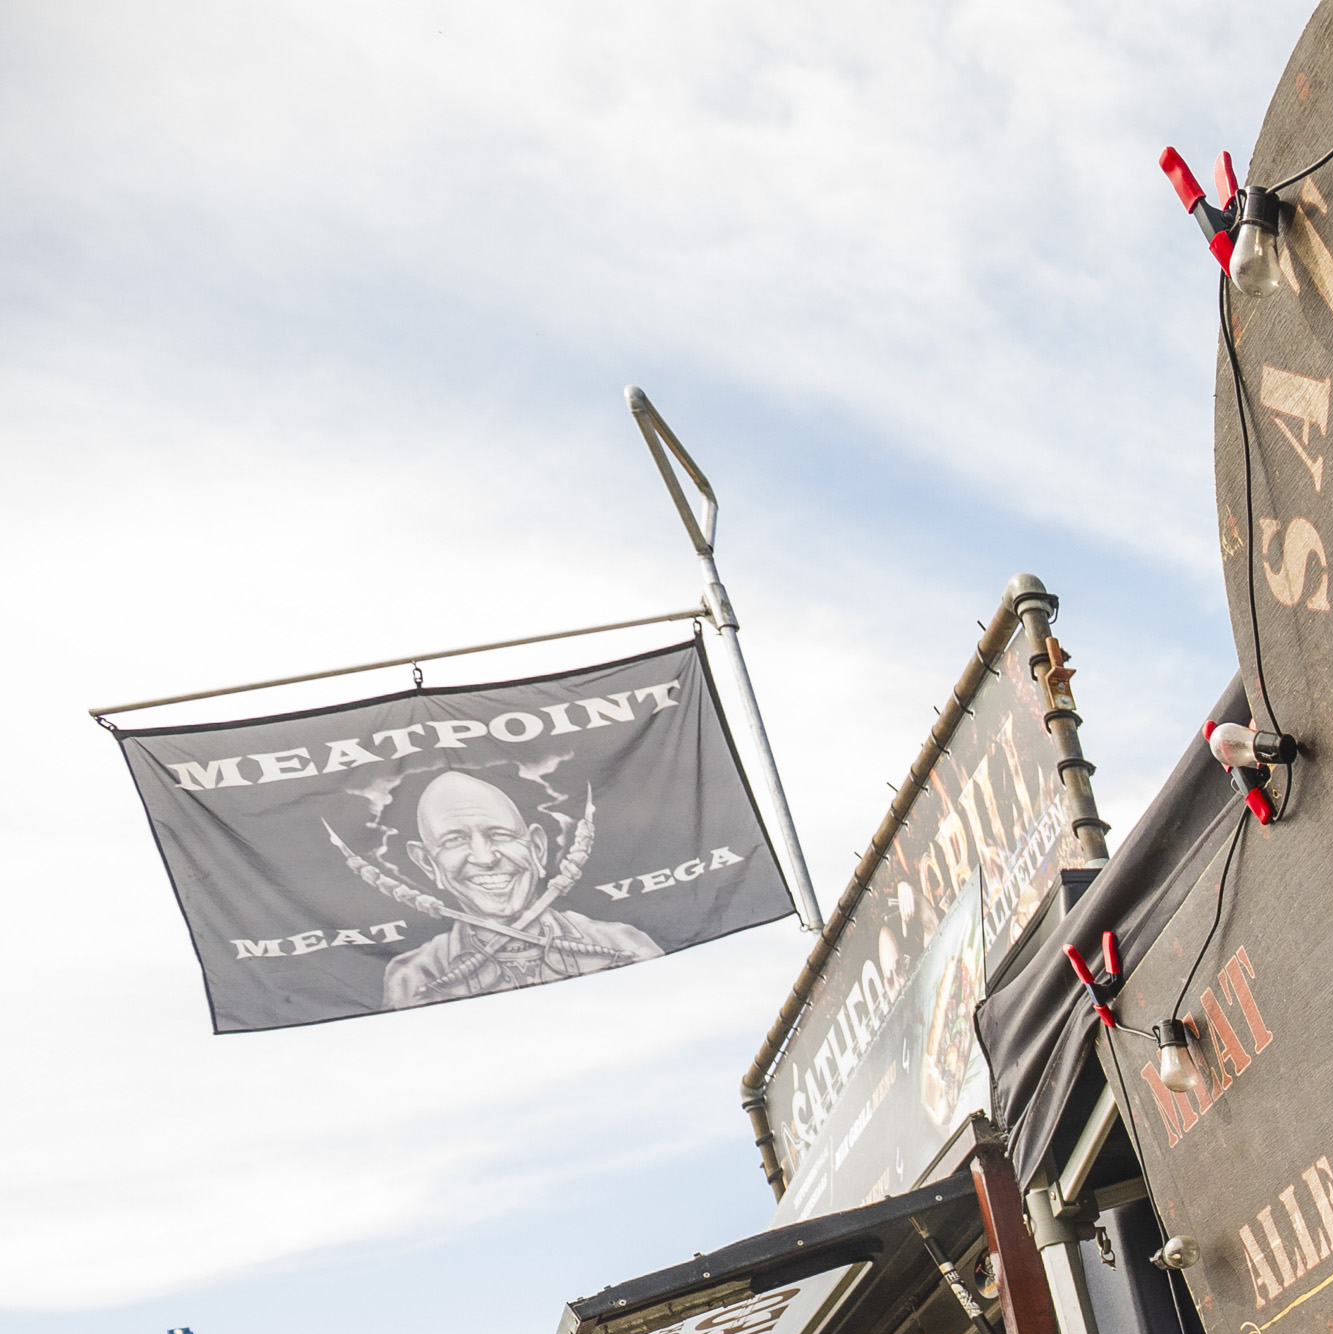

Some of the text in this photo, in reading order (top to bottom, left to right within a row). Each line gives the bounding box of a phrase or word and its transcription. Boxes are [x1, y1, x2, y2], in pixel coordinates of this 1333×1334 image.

[170, 680, 682, 792] MEATPOINT
[597, 845, 744, 902] VEGA
[983, 793, 1068, 945] ALITEITEN
[231, 920, 407, 960] MEAT
